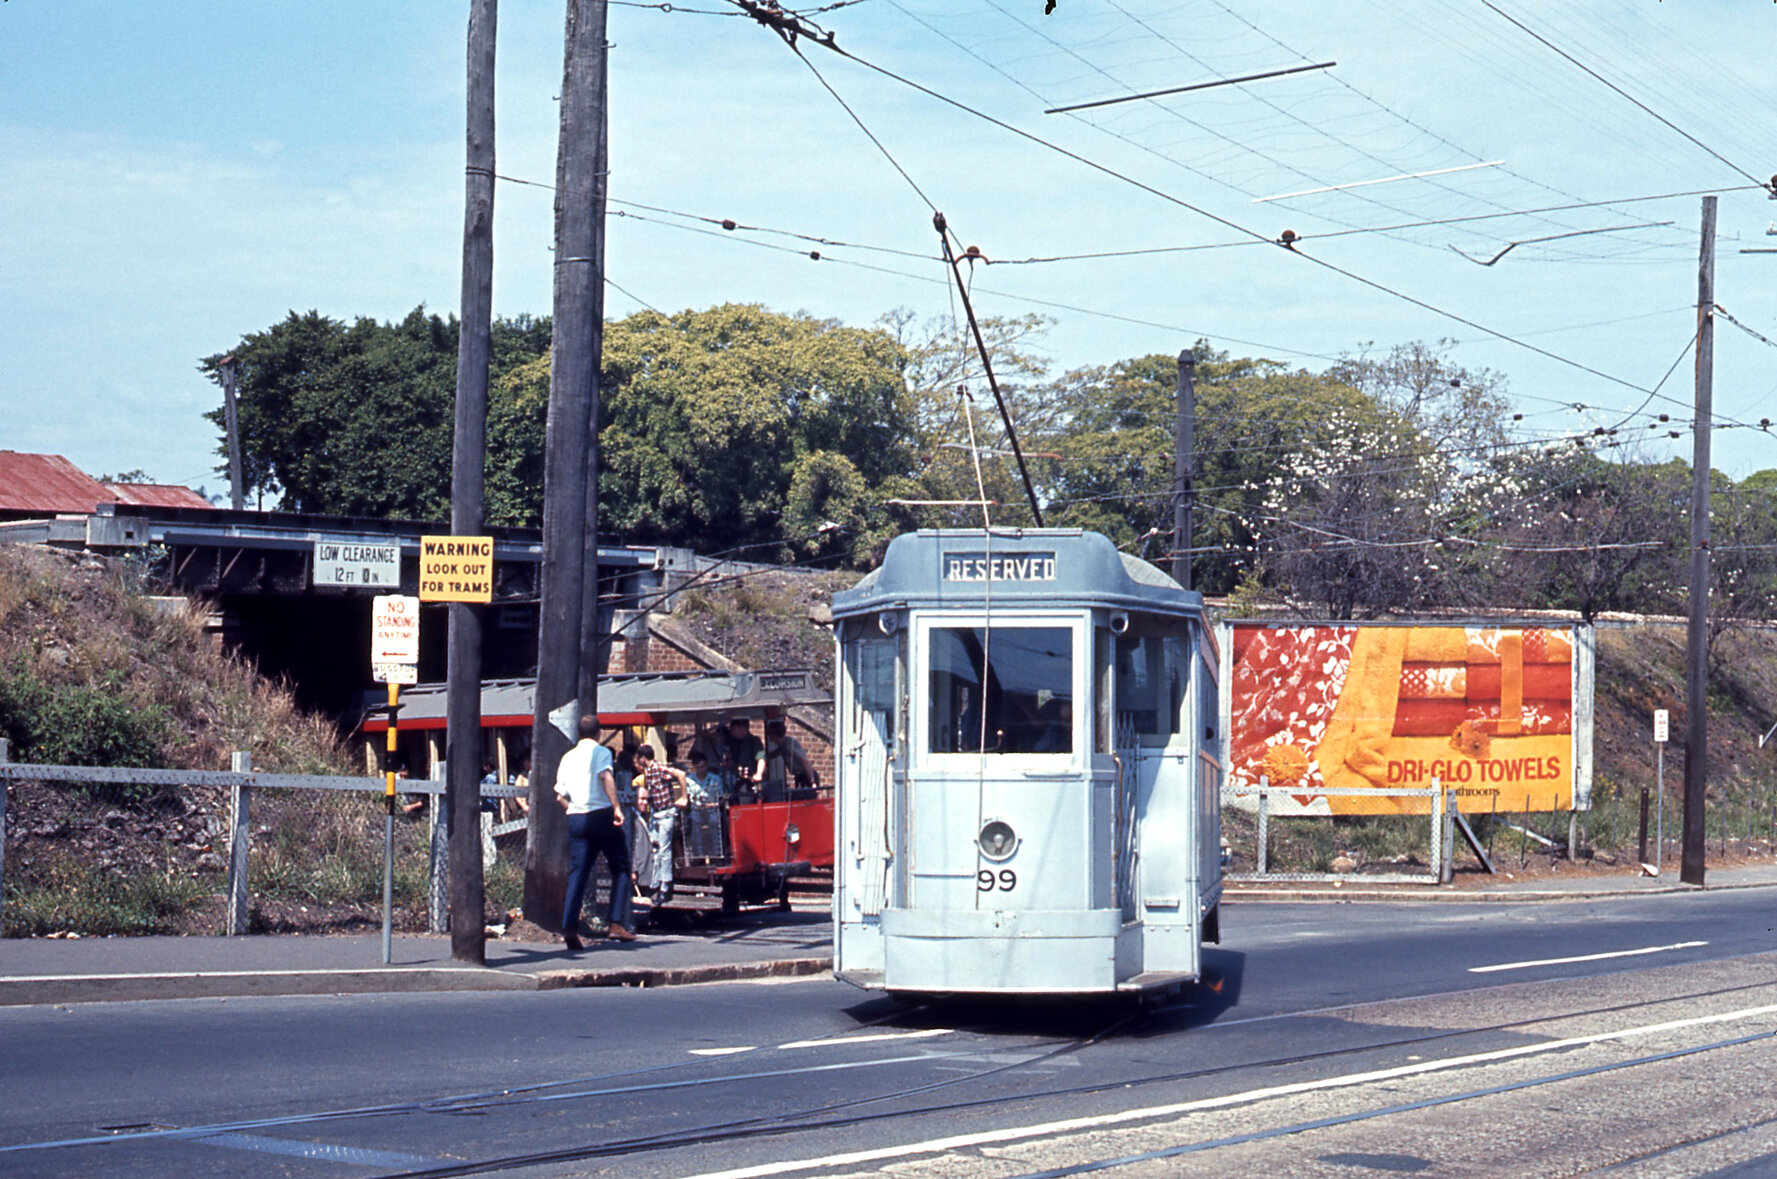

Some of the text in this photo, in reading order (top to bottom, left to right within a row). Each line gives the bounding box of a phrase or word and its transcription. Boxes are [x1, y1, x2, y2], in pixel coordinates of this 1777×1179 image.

[320, 546, 395, 564] LOW CLEARANCE
[424, 542, 490, 557] WARNING
[335, 568, 345, 582] 12
[426, 564, 486, 576] LOOK OUT
[949, 558, 1055, 581] RESERVED
[422, 582, 490, 594] FOR TRAMS
[387, 602, 405, 614] NO
[376, 616, 416, 628] STANDING
[377, 631, 413, 640] ANYTIME
[1476, 756, 1561, 781] TOWELS
[977, 869, 1017, 892] 99
